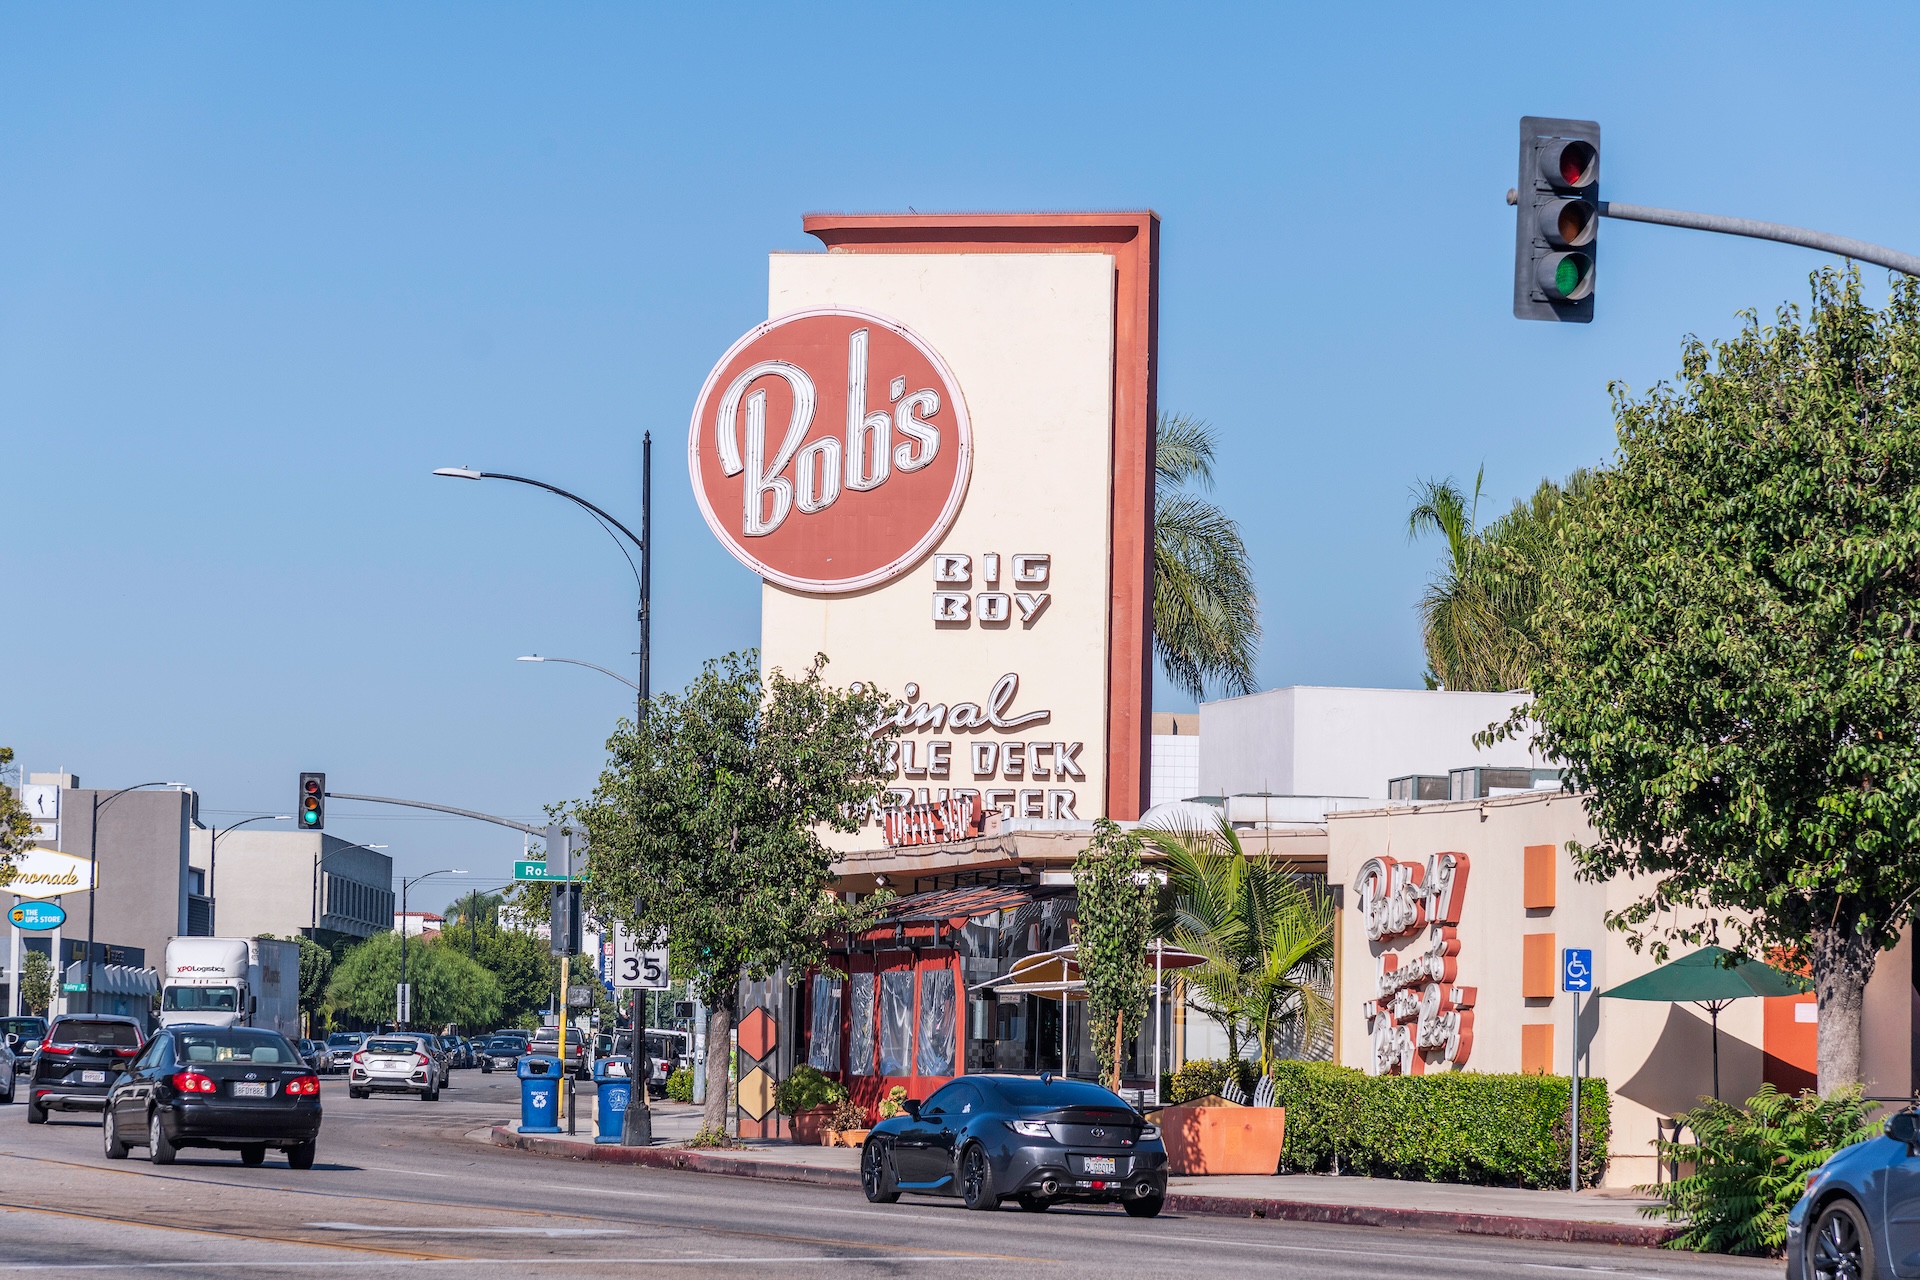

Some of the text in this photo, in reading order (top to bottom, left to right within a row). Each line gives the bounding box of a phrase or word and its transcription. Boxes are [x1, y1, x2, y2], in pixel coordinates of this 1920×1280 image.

[715, 327, 941, 537] Bob's
[933, 553, 1051, 583] BIG
[932, 592, 1051, 622] BOY
[970, 740, 1084, 777] DECK
[604, 956, 613, 983] bank
[621, 957, 661, 981] 35
